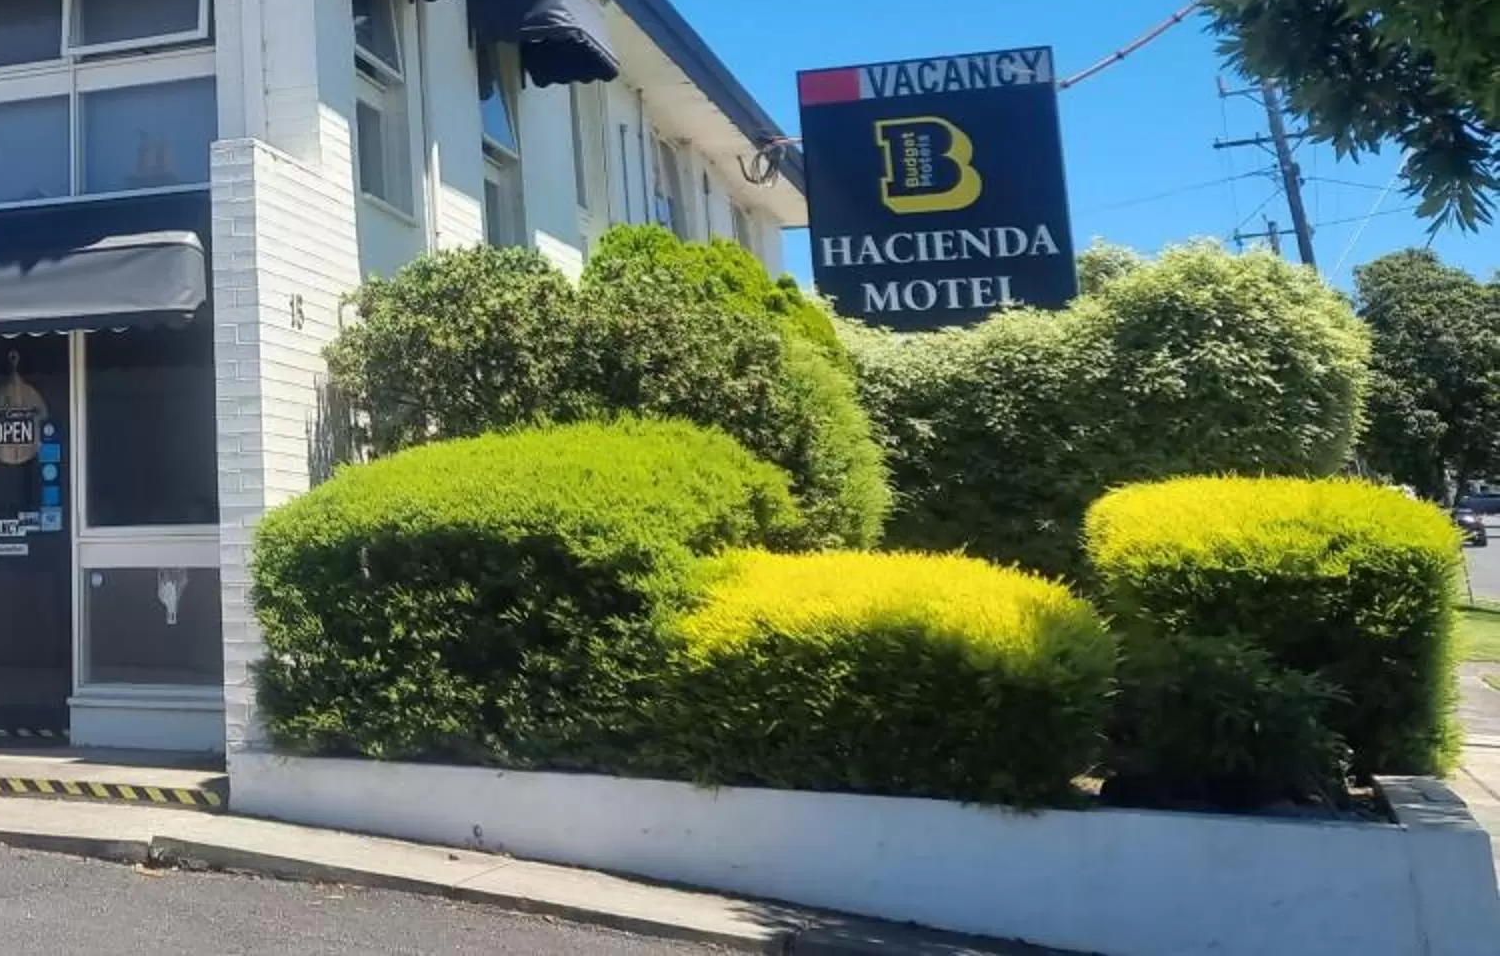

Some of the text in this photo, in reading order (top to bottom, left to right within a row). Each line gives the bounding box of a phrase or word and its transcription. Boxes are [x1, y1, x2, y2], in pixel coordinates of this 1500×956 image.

[867, 51, 1043, 97] VACANCY
[874, 116, 982, 213] B
[902, 132, 919, 188] Budget
[821, 224, 1060, 267] HACIENDA
[861, 276, 1024, 313] MOTEL
